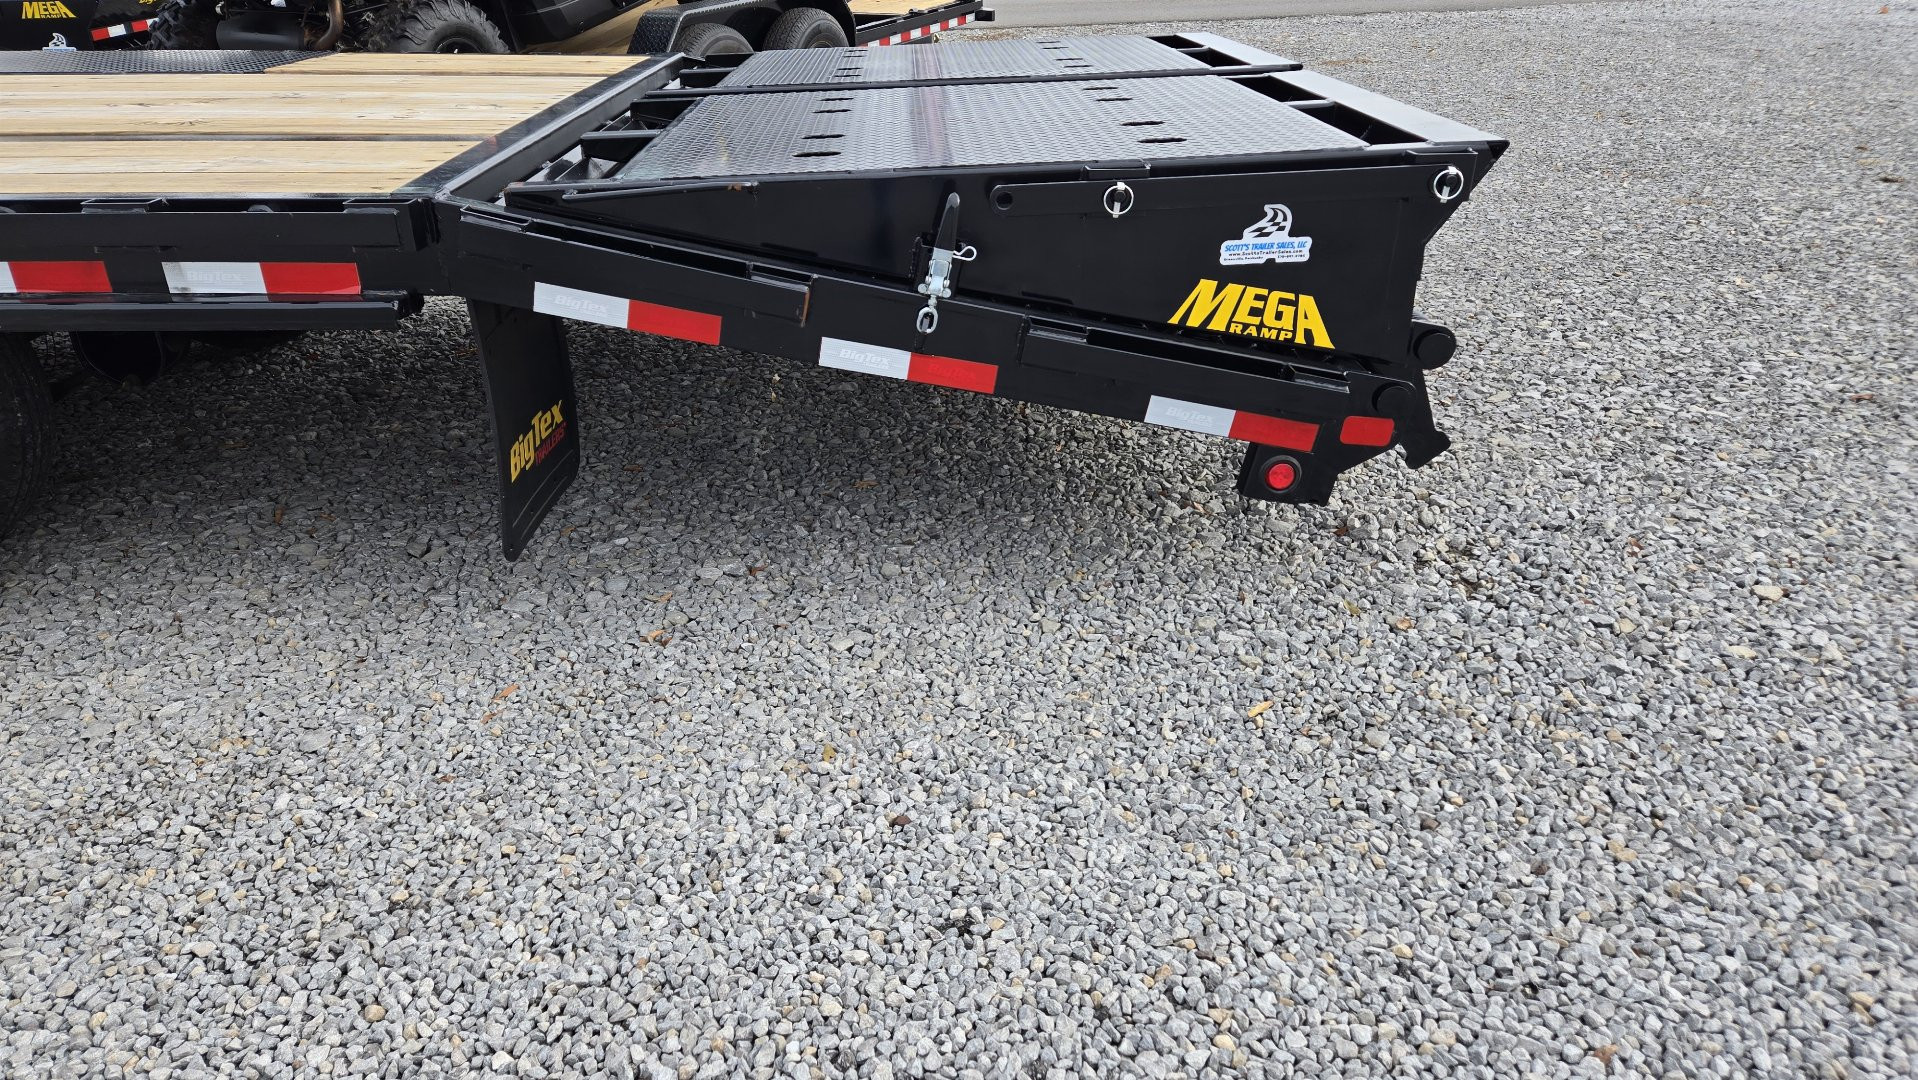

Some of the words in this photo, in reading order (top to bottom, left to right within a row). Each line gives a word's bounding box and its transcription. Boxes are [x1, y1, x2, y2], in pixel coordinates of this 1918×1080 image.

[22, 1, 77, 19] MEGA
[1225, 243, 1250, 252] SCOTT'S
[1252, 242, 1275, 250] TRAILER
[1276, 241, 1295, 249] SALES,
[1297, 240, 1308, 248] LLC
[554, 294, 608, 314] BigTex
[1167, 278, 1336, 350] MEGA
[1229, 322, 1294, 342] RAMP
[839, 348, 891, 366] BigTex
[1165, 406, 1214, 424] BigTex
[510, 400, 564, 484] BigTex
